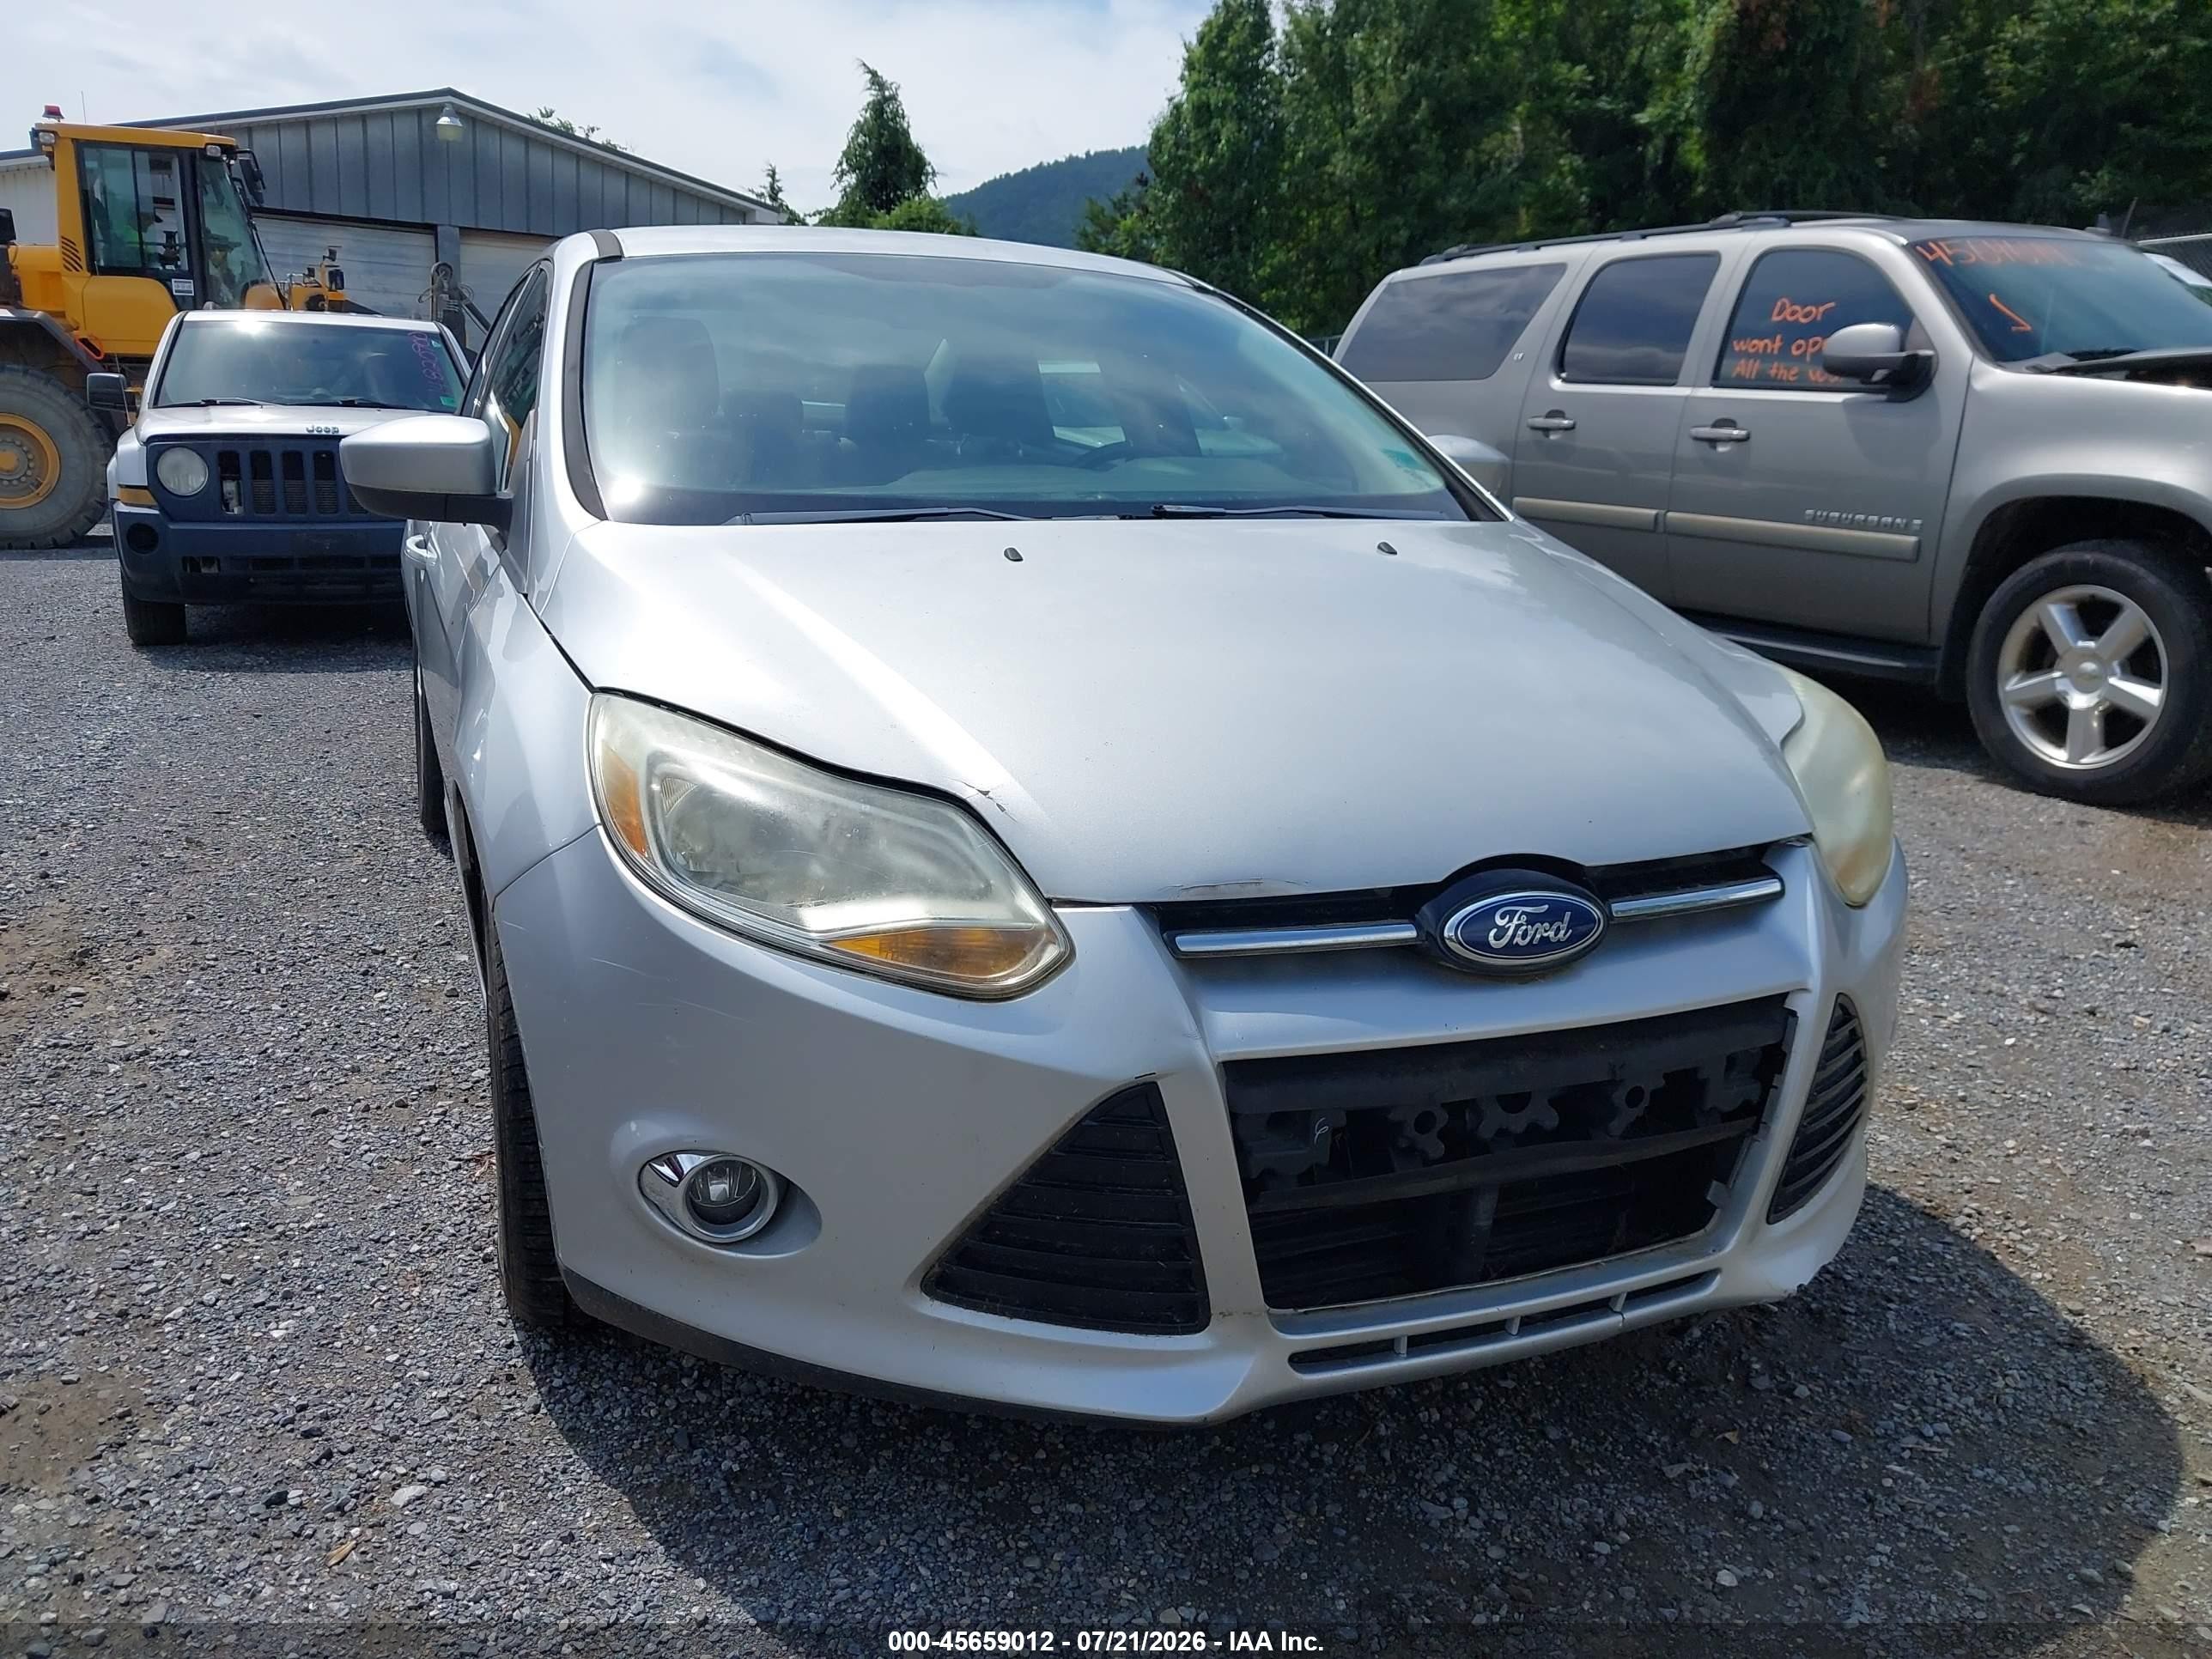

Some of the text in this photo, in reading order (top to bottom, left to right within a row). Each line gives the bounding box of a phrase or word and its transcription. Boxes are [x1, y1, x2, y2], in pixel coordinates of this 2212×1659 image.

[1771, 297, 1836, 324] Door
[1732, 334, 1783, 356] wont
[1731, 358, 1760, 380] All
[1769, 362, 1800, 380] the
[306, 424, 340, 434] Jeep
[1487, 904, 1573, 949] Ford
